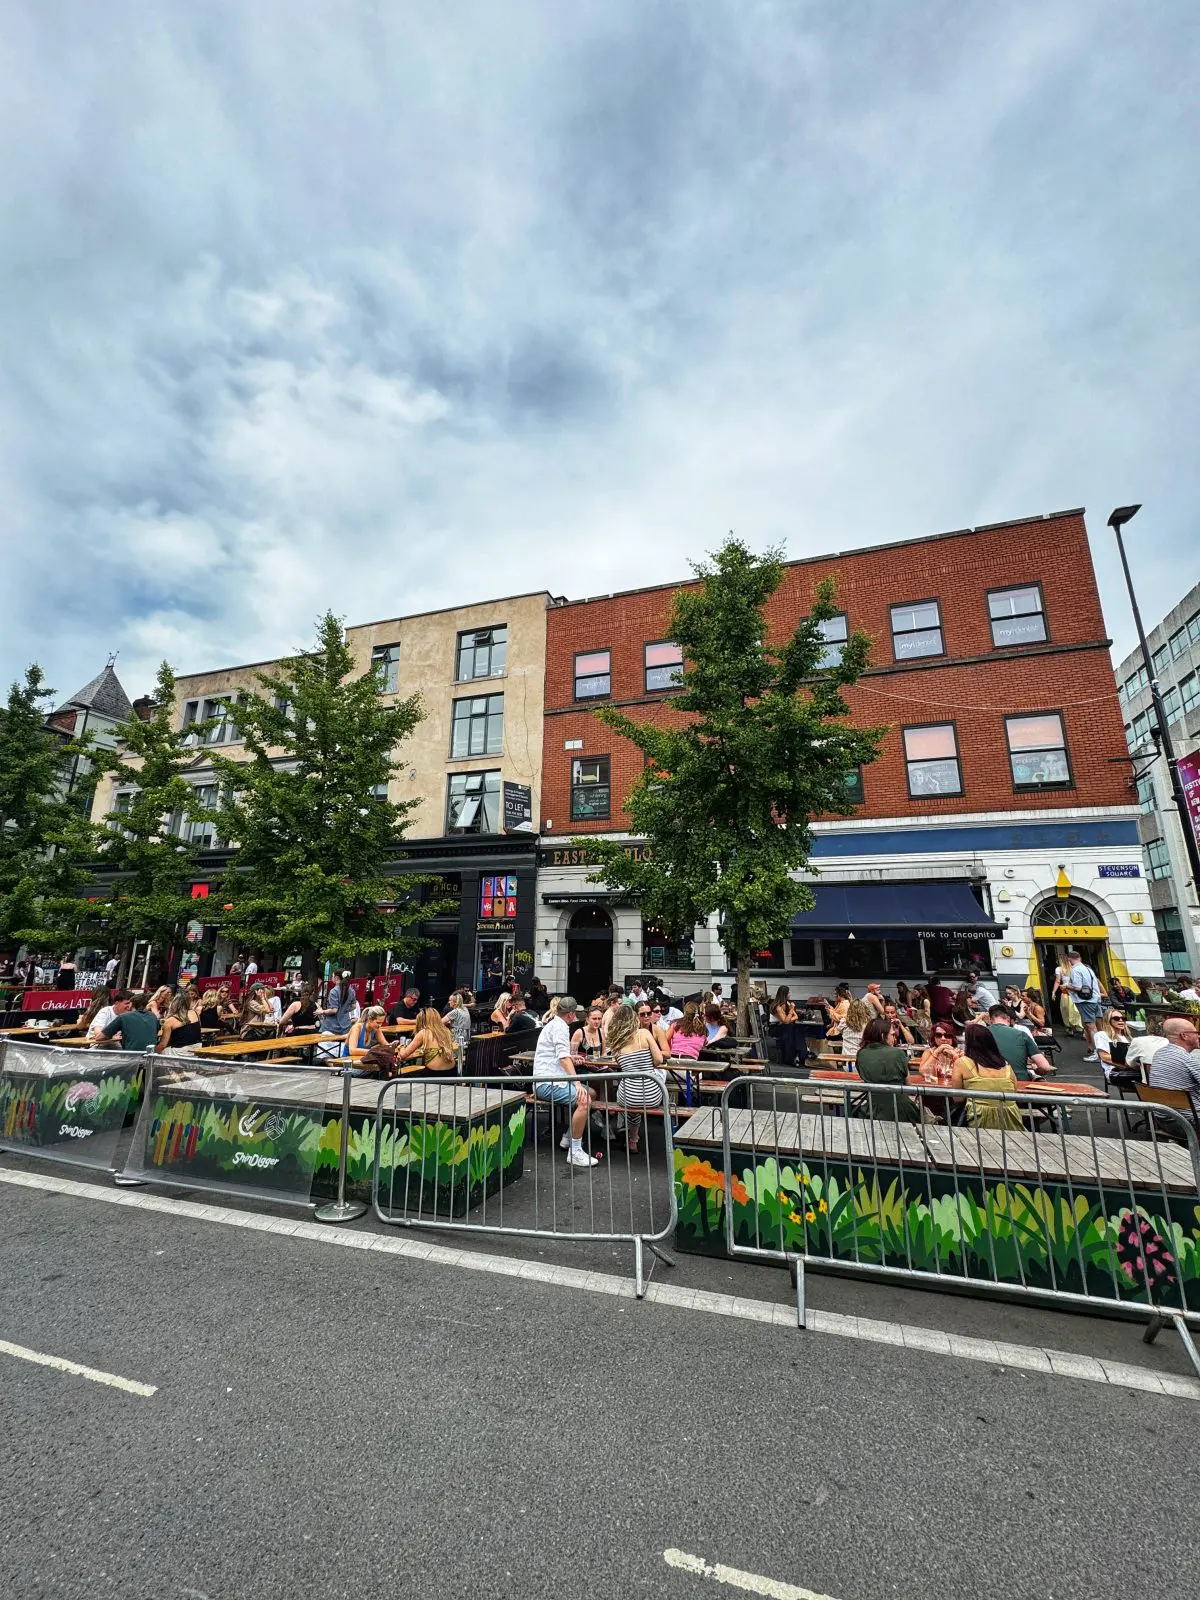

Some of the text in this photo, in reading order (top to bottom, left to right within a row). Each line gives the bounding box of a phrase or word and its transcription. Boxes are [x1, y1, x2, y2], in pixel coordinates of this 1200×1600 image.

[505, 801, 524, 812] TO LET
[953, 931, 997, 940] Incognito
[41, 998, 93, 1010] Chai LATT
[59, 1124, 93, 1139] ShinDigger
[232, 1152, 279, 1168] ShinDigger
